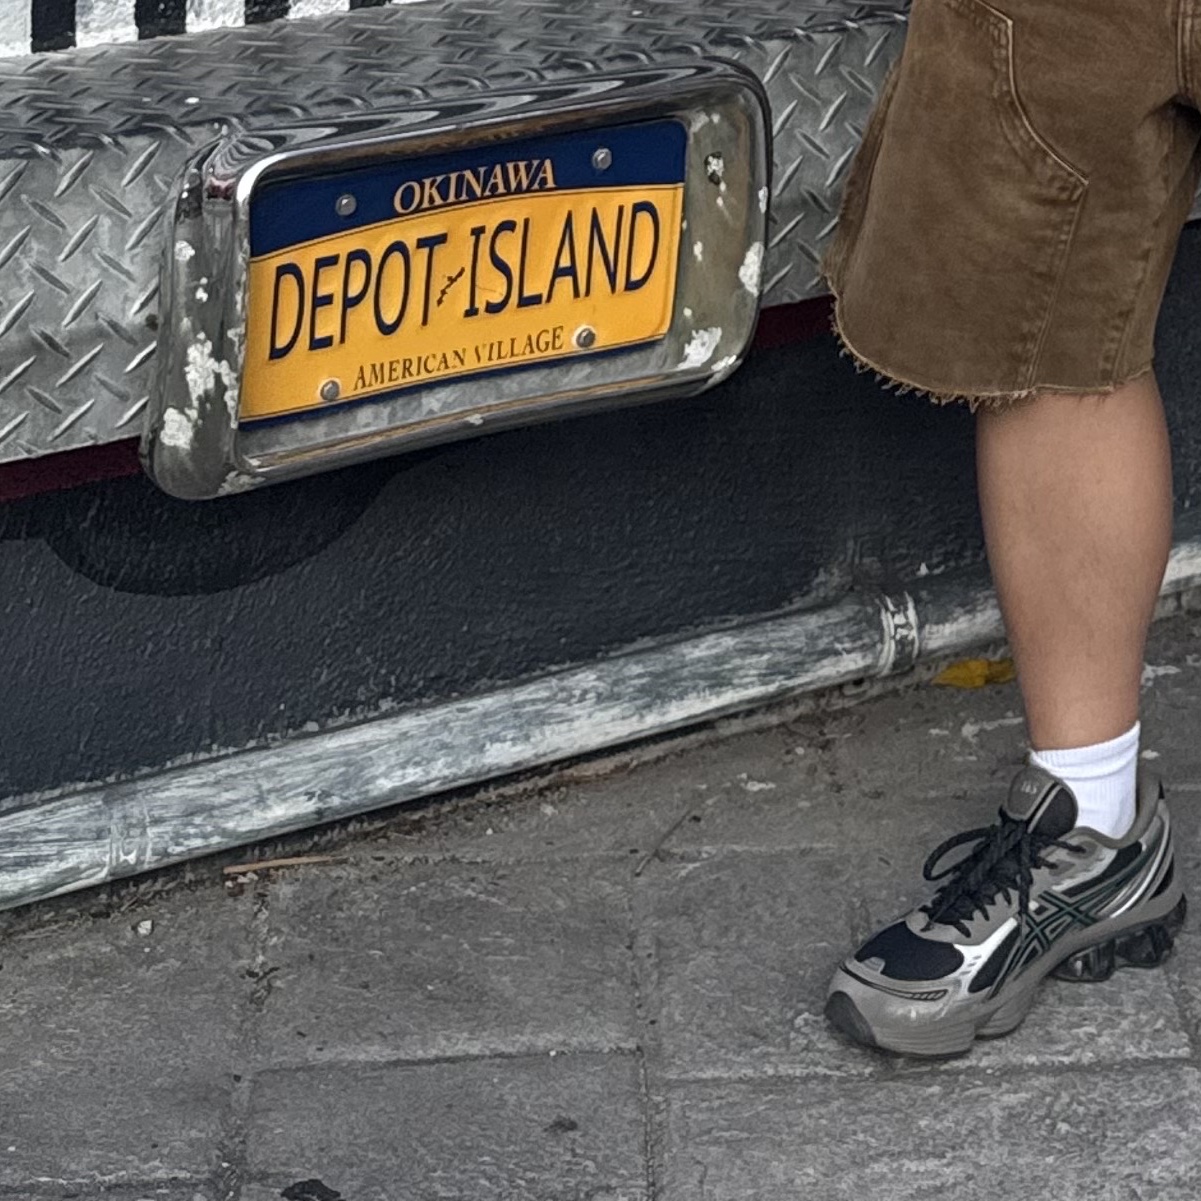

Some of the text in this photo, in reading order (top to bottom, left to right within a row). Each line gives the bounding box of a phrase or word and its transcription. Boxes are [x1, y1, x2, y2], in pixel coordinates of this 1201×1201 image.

[394, 158, 556, 214] OKINAWA
[268, 200, 660, 361] DEPOT ISLAND
[353, 325, 564, 391] AMERICAN VILLAGE
